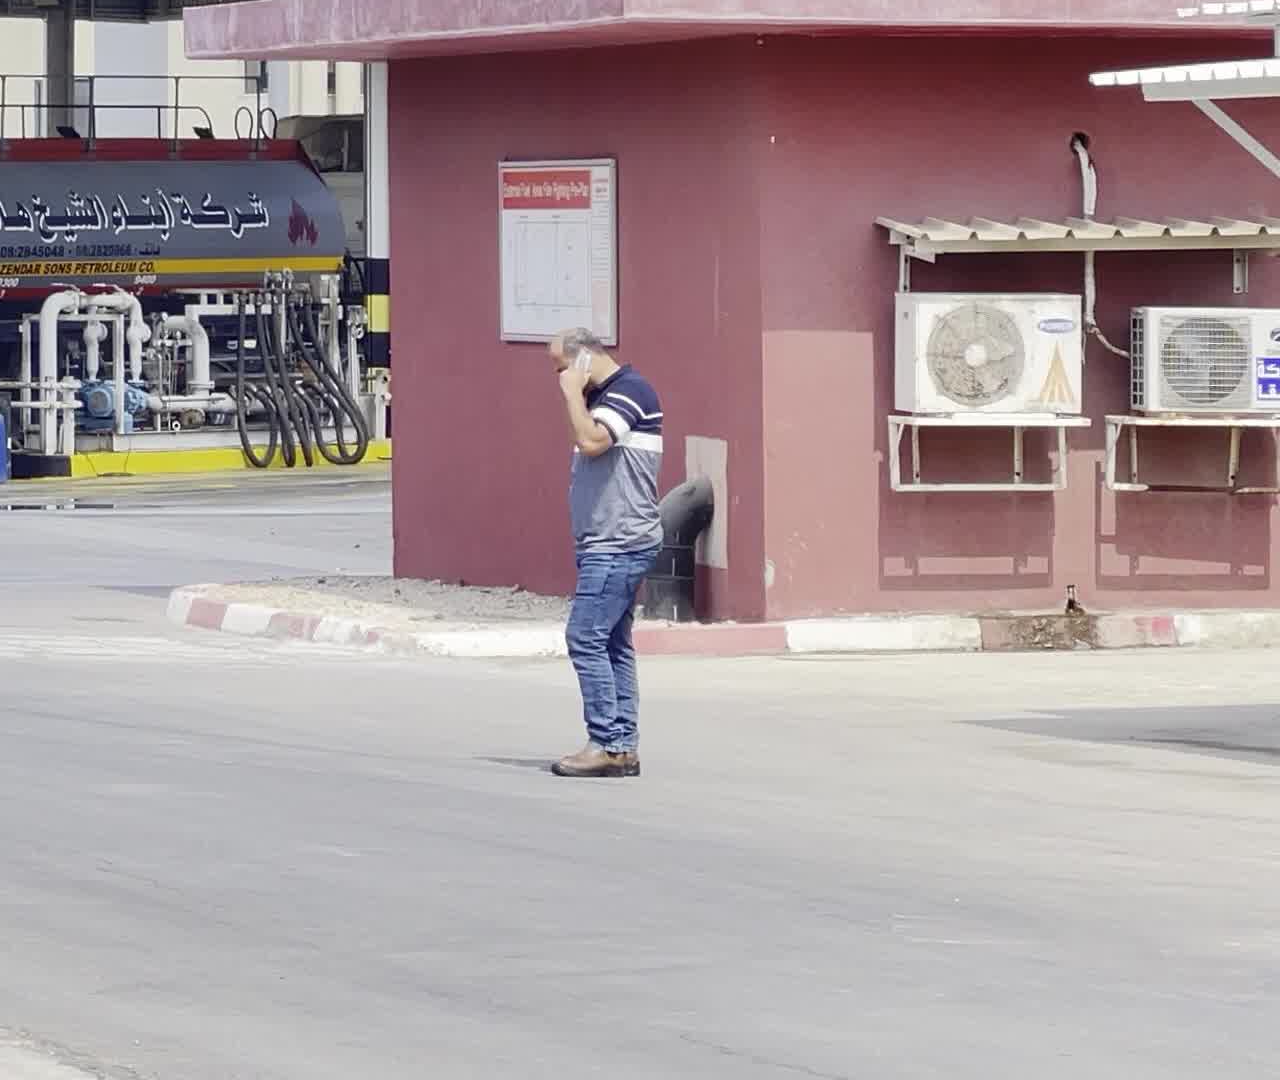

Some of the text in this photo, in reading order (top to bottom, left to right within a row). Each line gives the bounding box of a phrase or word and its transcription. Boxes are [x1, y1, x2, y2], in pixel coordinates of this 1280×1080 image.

[31, 189, 109, 243] الشيخ
[171, 191, 270, 239] شركة
[43, 262, 73, 275] SONS
[73, 261, 137, 274] PETROLEUM
